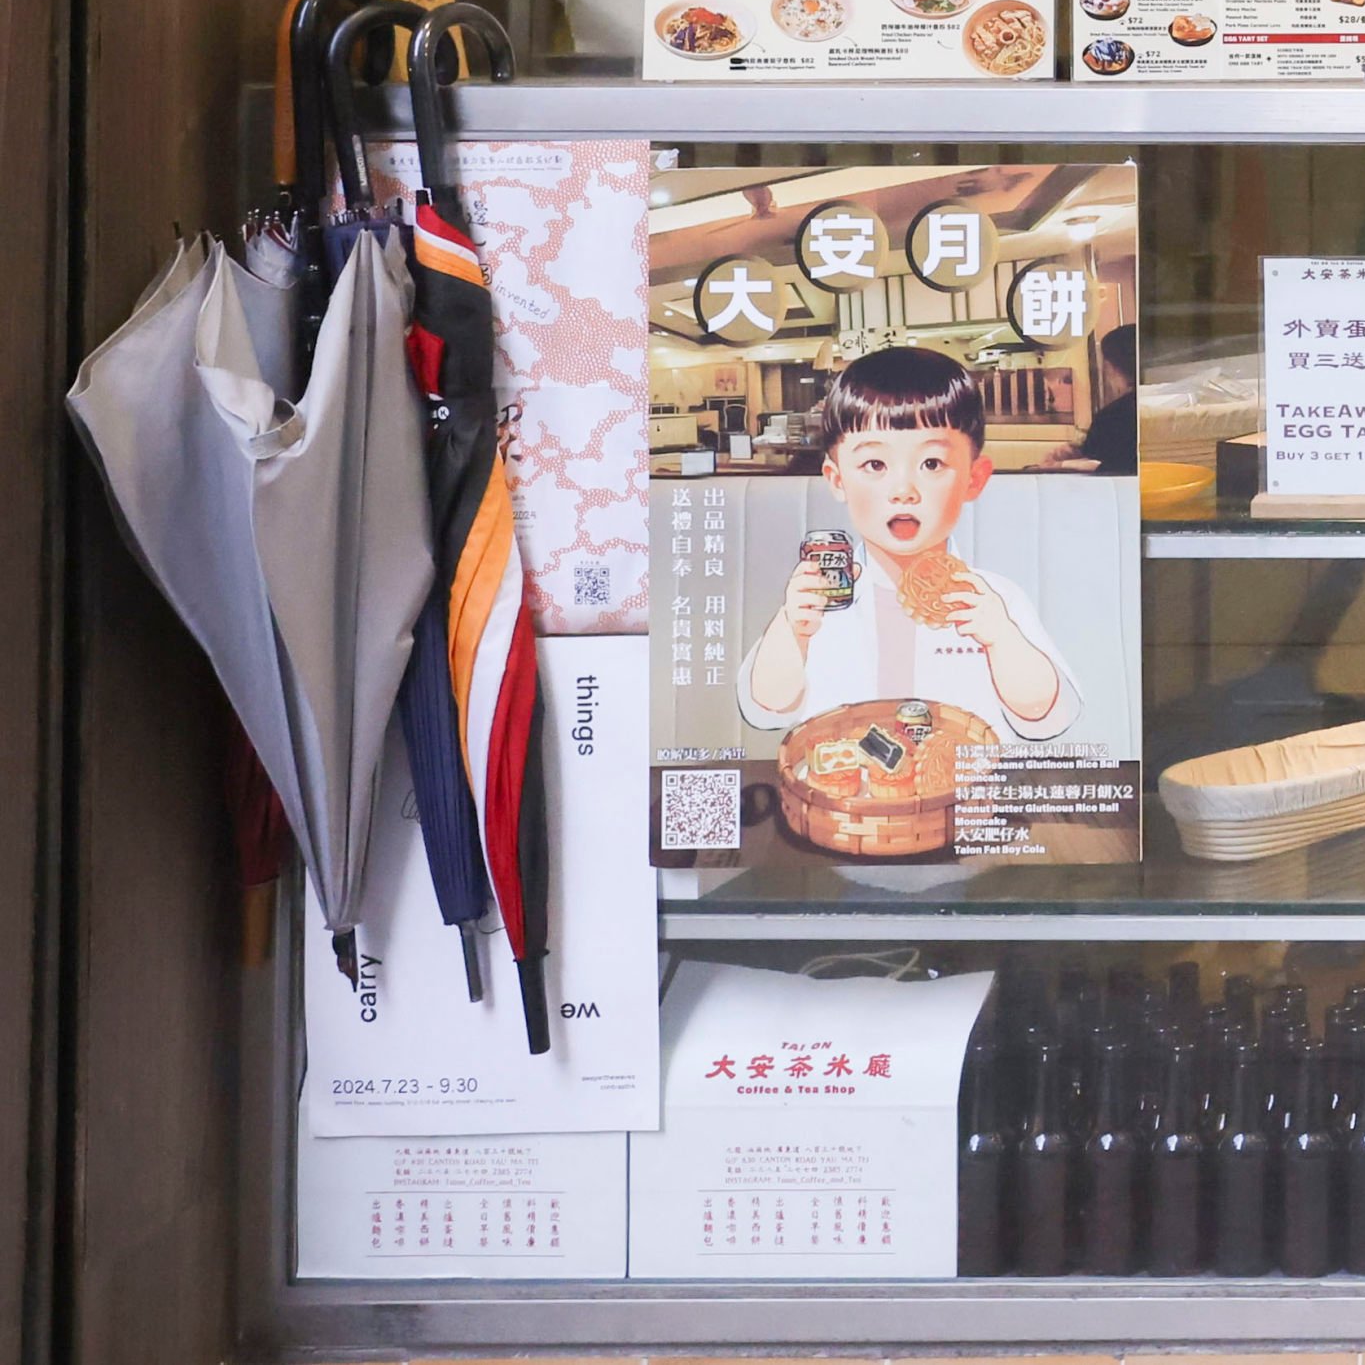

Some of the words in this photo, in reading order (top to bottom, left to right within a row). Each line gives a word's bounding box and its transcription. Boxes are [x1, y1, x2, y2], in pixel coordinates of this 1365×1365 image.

[707, 212, 1087, 336] 大安月餅
[1283, 424, 1332, 438] EGG
[1275, 450, 1305, 461] BUY
[1309, 450, 1319, 461] 3
[1324, 451, 1351, 461] GET
[671, 487, 693, 578] 送禮自奉
[703, 487, 726, 577] 出品精良
[671, 595, 693, 686] 名貴實惠
[703, 595, 726, 685] 用料純正
[573, 675, 601, 757] things
[1025, 759, 1074, 770] Glutinous
[1076, 759, 1098, 769] Rice
[1099, 758, 1120, 769] Ball
[954, 772, 1008, 783] Mooncake
[954, 803, 990, 814] Peanut
[991, 803, 1024, 813] Butter
[1025, 802, 1074, 813] Glutinous
[1075, 802, 1098, 813] Rice
[1099, 802, 1120, 813] Ball
[954, 816, 1008, 827] Mooncake
[955, 826, 1030, 843] 大安肥仔水
[984, 845, 1001, 855] Fat
[1003, 845, 1021, 856] Boy
[1022, 845, 1046, 855] Cola
[359, 954, 384, 1024] carry
[780, 1040, 806, 1052] TAI
[810, 1040, 833, 1051] ON
[332, 1078, 420, 1094] 2024.7.23
[439, 1077, 479, 1093] 9.30
[736, 1085, 780, 1095] Coffee
[784, 1085, 793, 1095] &
[797, 1085, 820, 1095] Tea
[824, 1085, 856, 1096] Shop
